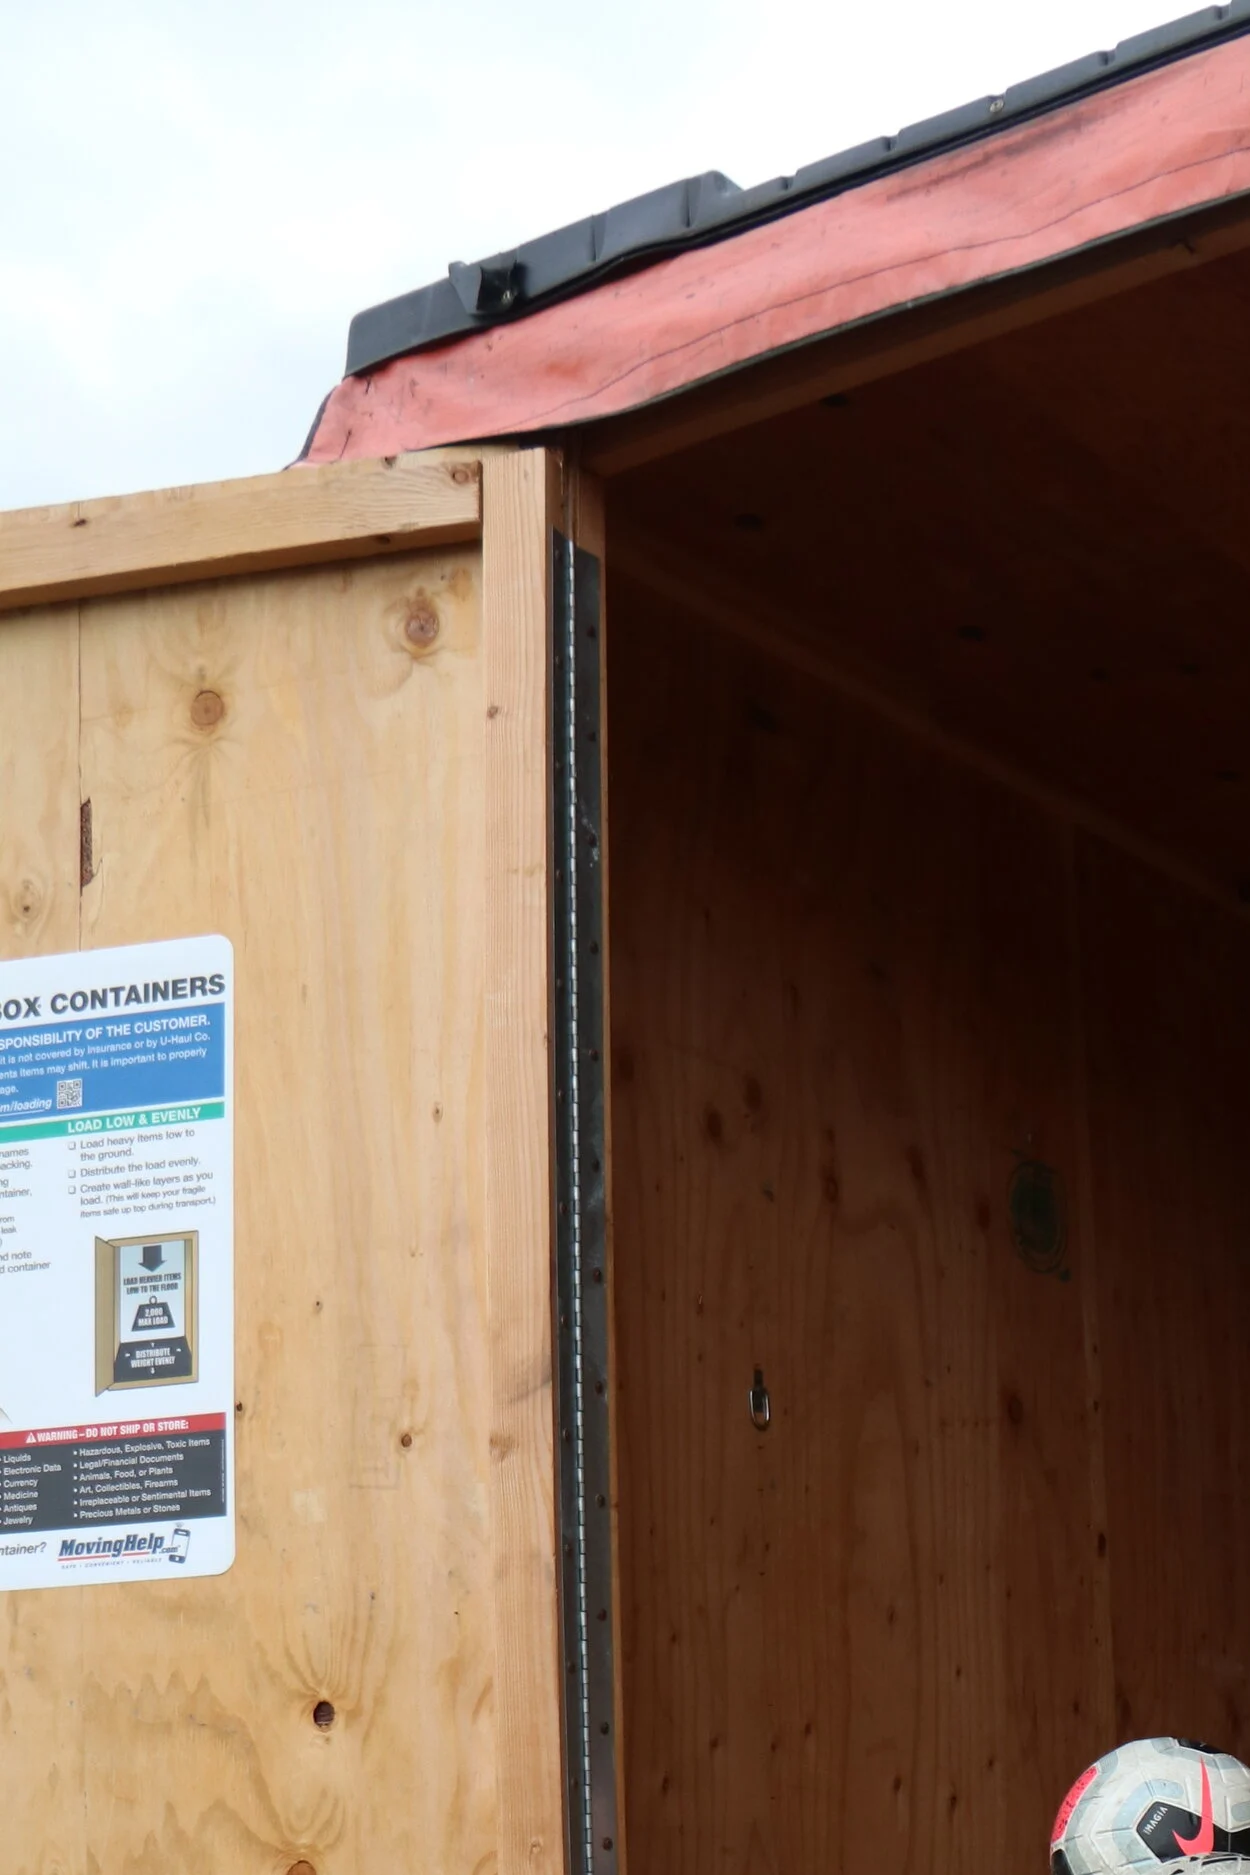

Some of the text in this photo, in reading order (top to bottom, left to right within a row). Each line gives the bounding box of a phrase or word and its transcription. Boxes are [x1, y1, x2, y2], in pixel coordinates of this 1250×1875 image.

[0, 973, 225, 1020] OX CONTAINERS
[0, 1014, 211, 1050] SPONSIBILITY OF THE CUSTOMER.
[8, 1055, 16, 1064] is
[18, 1052, 33, 1062] not
[35, 1047, 72, 1061] covered
[73, 1046, 86, 1057] by
[87, 1041, 132, 1054] insurance
[134, 1040, 144, 1049] or
[146, 1037, 158, 1049] by
[160, 1032, 192, 1046] U-Haul
[194, 1031, 211, 1042] Co.
[0, 1047, 208, 1080] ents items may shift. It is important to properly
[0, 1085, 19, 1096] age.
[0, 1097, 52, 1112] m/loading
[67, 1107, 201, 1133] LOAD LOW & EVENLY
[80, 1128, 195, 1149] Load heavy items low to
[80, 1147, 134, 1162] the ground.
[0, 1159, 32, 1170] acking.
[80, 1156, 201, 1178] Distribute the load evenly.
[80, 1171, 214, 1193] Create wall-like layers as you
[0, 1187, 32, 1199] ntainer.
[80, 1185, 206, 1206] load. (This will keep your fragile
[80, 1209, 101, 1219] items
[103, 1206, 119, 1216] safe
[121, 1206, 132, 1216] up
[133, 1203, 146, 1214] top
[148, 1200, 174, 1212] during
[0, 1215, 15, 1223] rom
[11, 1250, 32, 1260] note
[7, 1261, 51, 1273] container
[123, 1276, 138, 1286] LOAD
[164, 1272, 182, 1282] ITEMS
[126, 1286, 139, 1295] LOW
[144, 1307, 163, 1317] 2,000
[138, 1315, 168, 1327] MAX LOAD
[135, 1348, 171, 1359] DISTRIBUTE
[131, 1358, 154, 1369] WEIGHT
[37, 1420, 189, 1443] WARNING DO NOT SHIP OR STORE:
[79, 1437, 211, 1457] Hazardous, Explosive, Toxic Items
[3, 1453, 32, 1464] Liquids
[79, 1452, 184, 1470] Legal/Financial Documents
[3, 1464, 62, 1476] Electronic Data
[79, 1465, 174, 1482] Animals, Food, or Plants
[3, 1478, 39, 1489] Currency
[79, 1478, 179, 1494] Art, Collectibles, Firearms
[3, 1490, 39, 1500] Medicine
[79, 1487, 212, 1507] Irreplaceable or Sentimental Items
[3, 1503, 38, 1513] Antiques
[79, 1503, 181, 1519] Precious Metals or Stones
[3, 1515, 34, 1526] Jewelry
